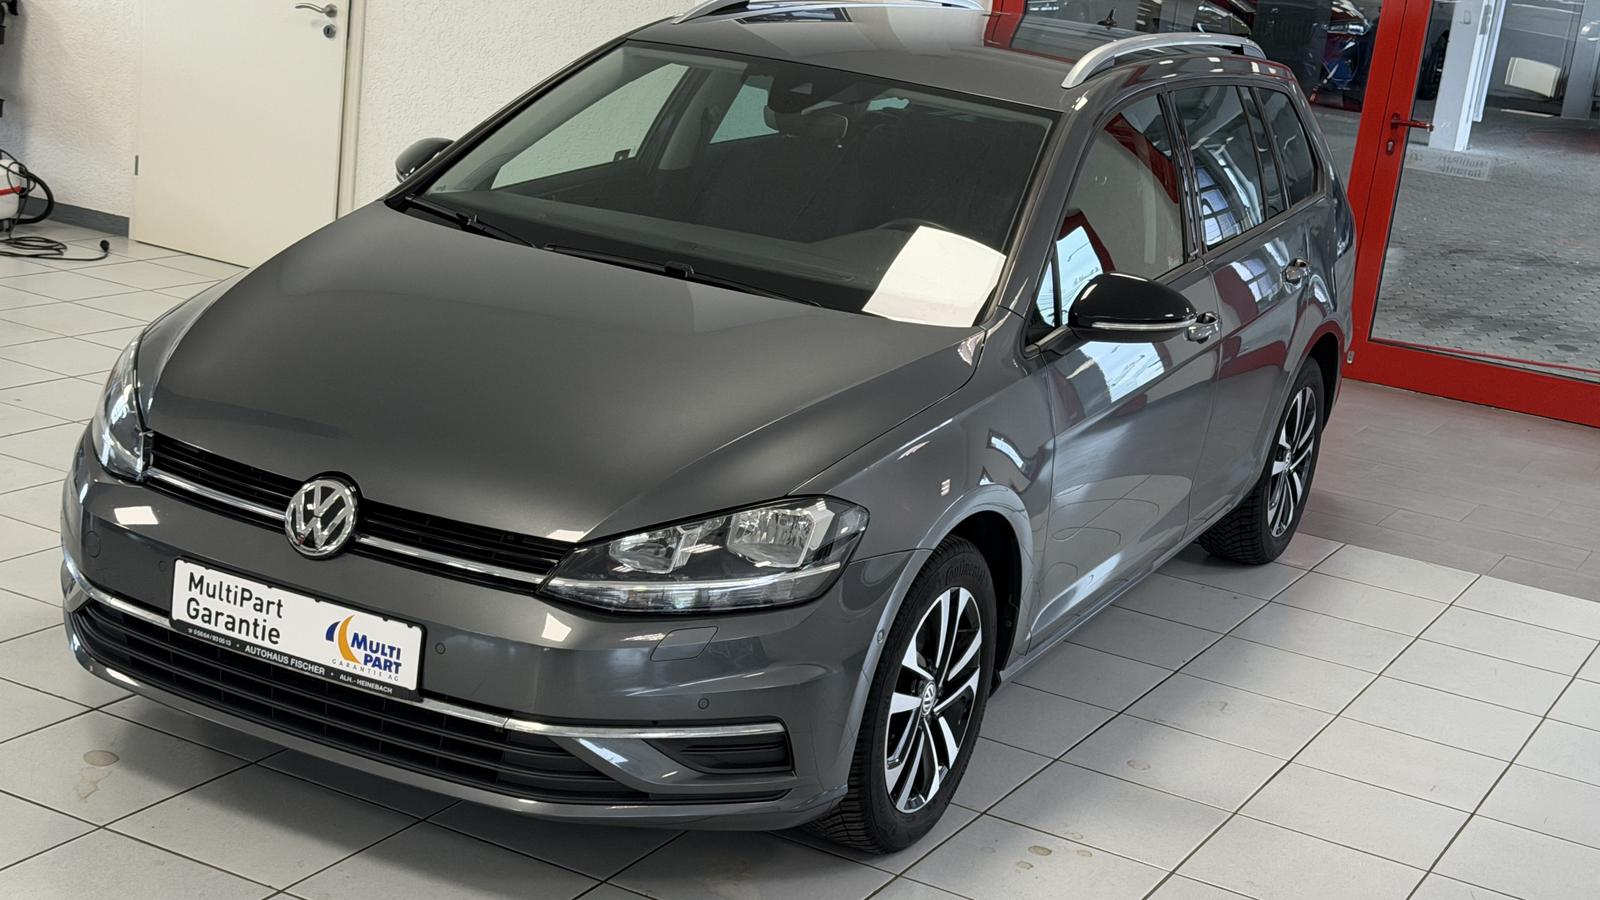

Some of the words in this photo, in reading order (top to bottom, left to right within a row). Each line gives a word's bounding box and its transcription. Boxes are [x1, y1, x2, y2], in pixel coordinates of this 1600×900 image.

[188, 571, 284, 619] MultiPart
[186, 597, 281, 645] Garantie
[244, 645, 289, 665] AUTOHAUS
[290, 658, 326, 676] FISCHER
[351, 632, 401, 660] MULTI
[331, 658, 382, 677] GARANTIE
[388, 674, 399, 682] AG
[363, 653, 402, 674] PART
